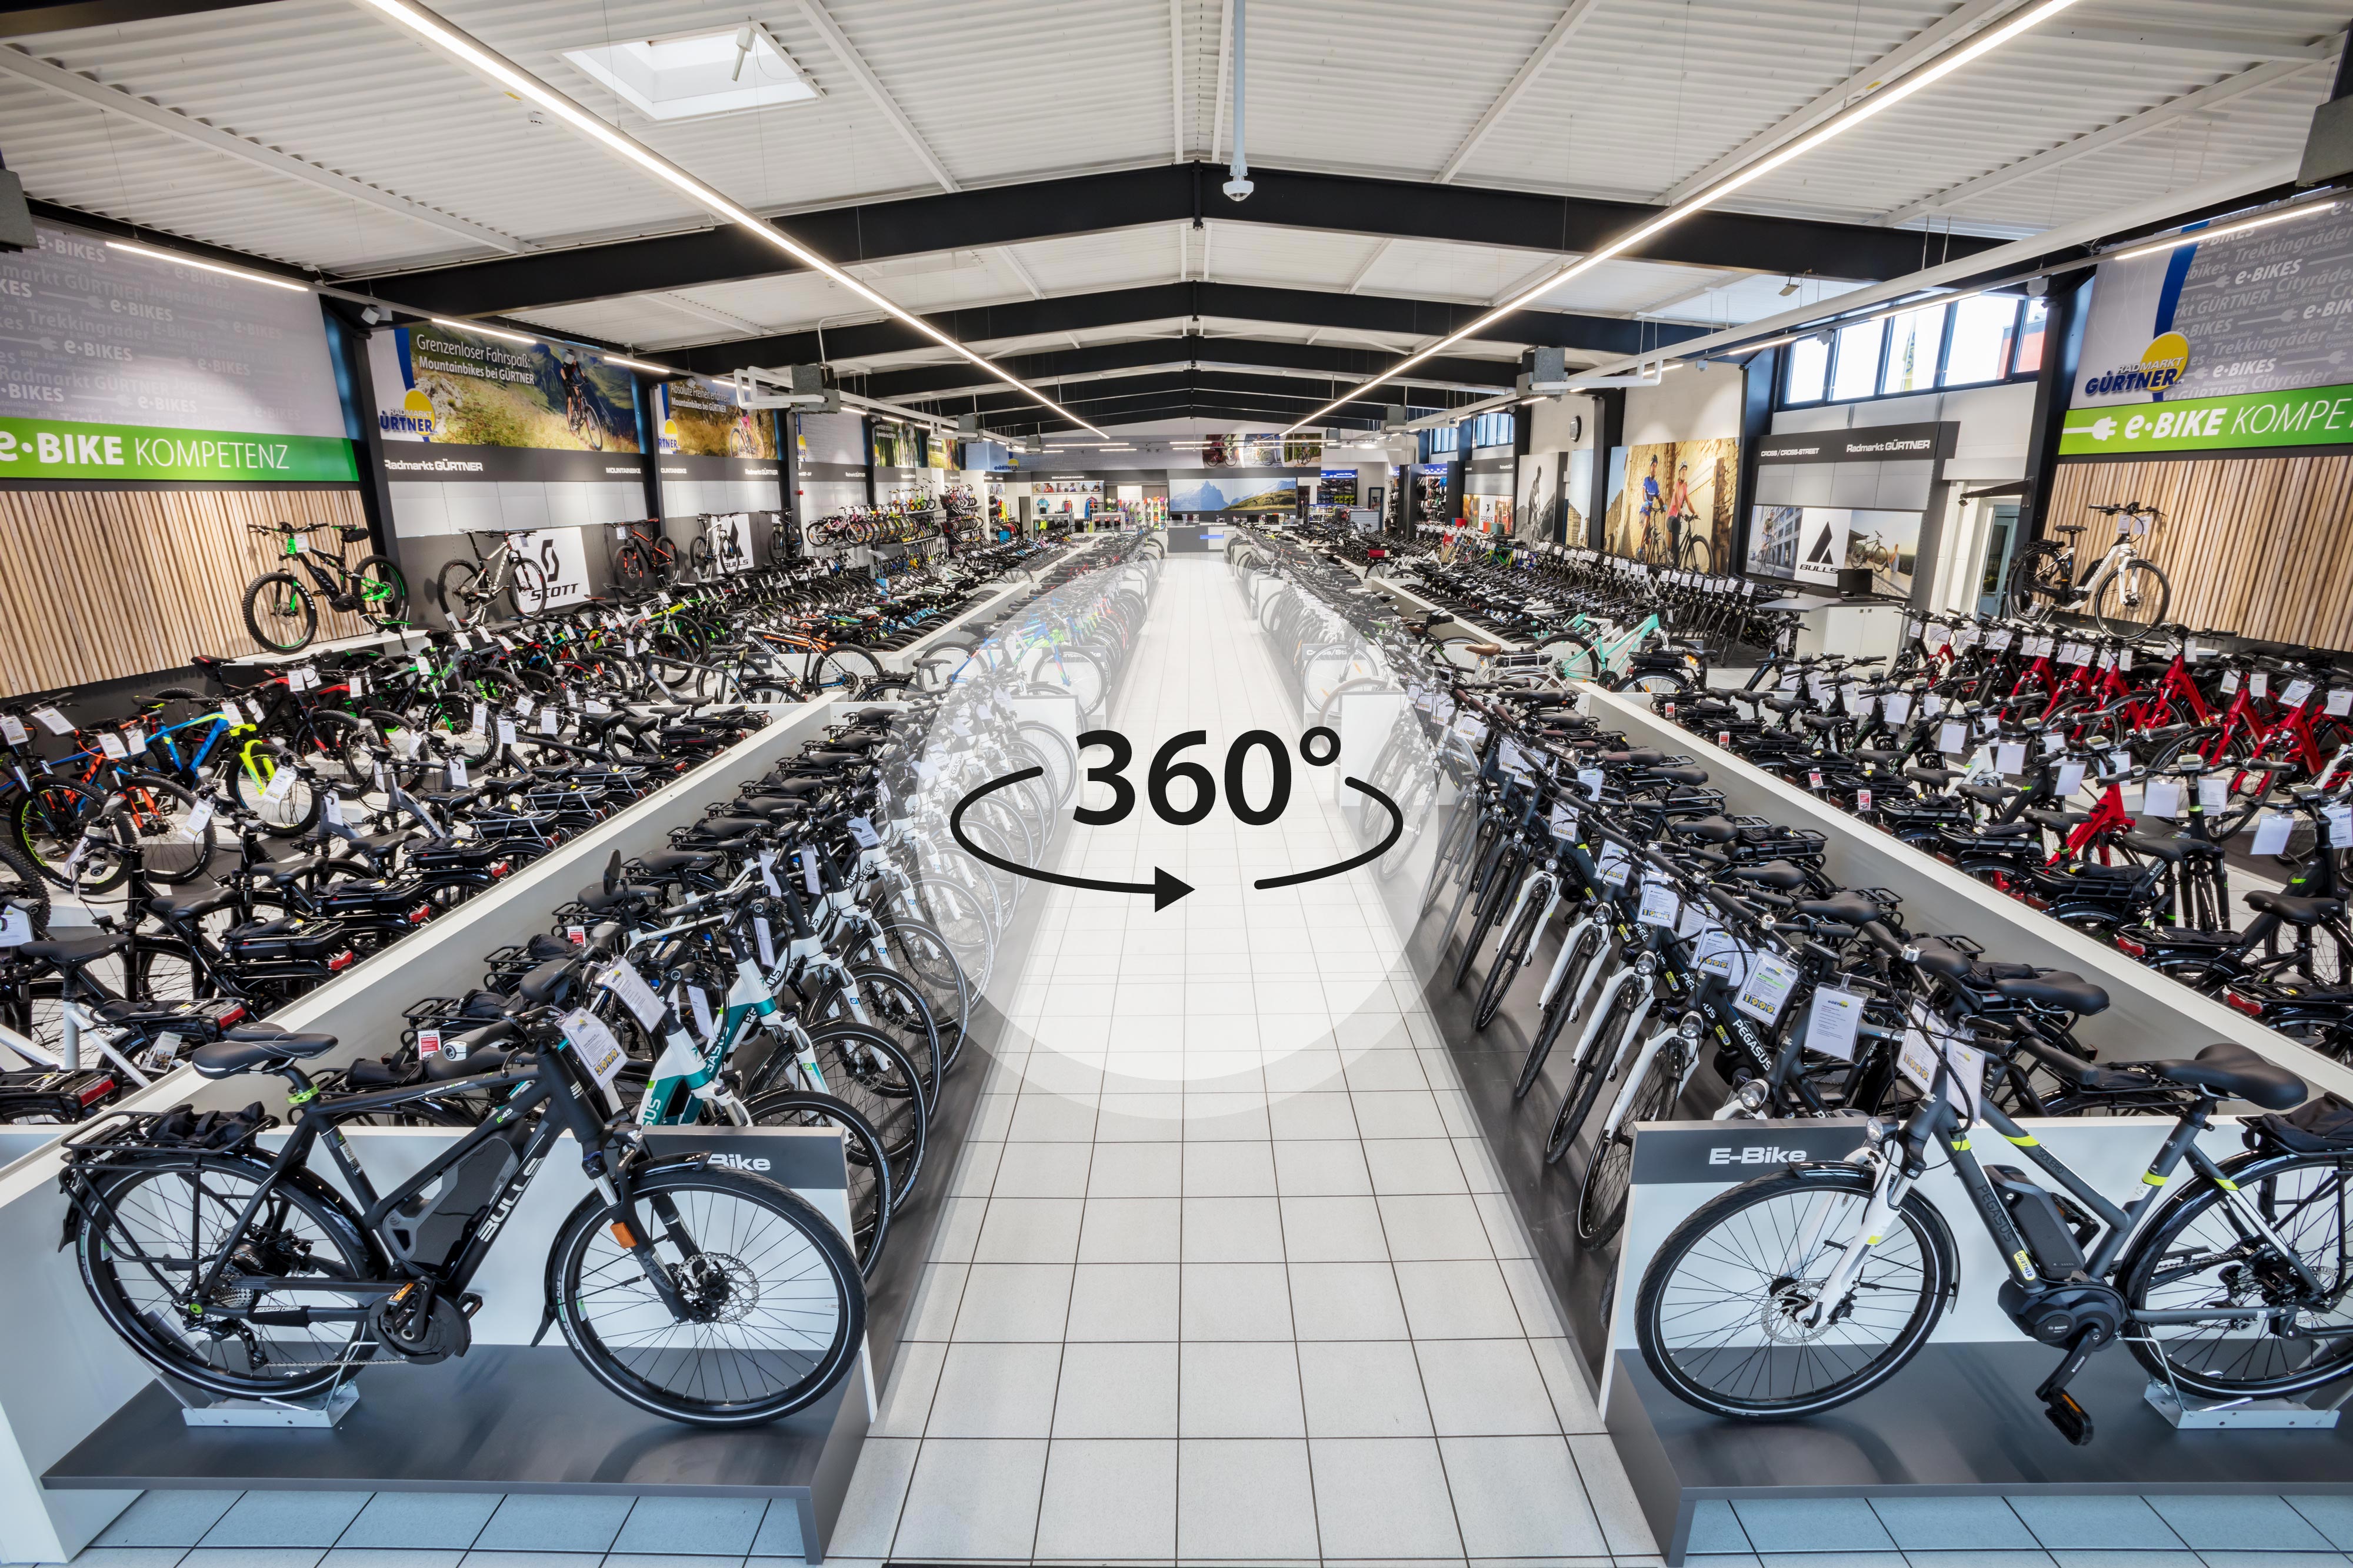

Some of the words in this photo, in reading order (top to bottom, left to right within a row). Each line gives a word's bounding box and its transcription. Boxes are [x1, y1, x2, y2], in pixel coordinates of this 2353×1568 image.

[2197, 288, 2271, 315] GÜRTNER
[26, 309, 149, 341] Trekkingräder
[416, 333, 484, 360] Grenzenloser
[486, 346, 531, 369] Fahrspaß:
[2212, 329, 2328, 356] Trekkingräder
[419, 355, 484, 377] Mountainbikes
[485, 368, 498, 378] bei
[499, 368, 534, 385] GÜRTNER
[2117, 355, 2185, 374] RADMARKT
[670, 383, 693, 397] Absolute
[2084, 368, 2178, 397] GÜRTNER
[2251, 368, 2334, 391] Cityräder
[389, 407, 432, 418] RADMARKT
[671, 396, 702, 410] Mountainbikes
[709, 402, 727, 413] GÜRTNER
[2231, 396, 2353, 436] KOMPE
[135, 438, 290, 469] KOMPETENZ
[1846, 443, 1884, 453] Radmarkt
[1884, 439, 1931, 452] GÜRTNER
[435, 458, 483, 472] GÜRTNER
[1799, 563, 1839, 575] BULLS
[1619, 925, 1629, 941] GÜRTNER
[1666, 972, 1678, 990] GÜRTNER
[1743, 993, 1775, 1016] 1999
[1716, 1025, 1729, 1045] GÜRTNER
[1732, 1019, 1772, 1072] PEGASUS
[1867, 1040, 1879, 1057] SOLERO
[595, 1049, 619, 1077] 3999
[1904, 1052, 1930, 1083] 1999
[425, 1086, 445, 1095] GREEN
[496, 1107, 513, 1124] E45
[1708, 1146, 1807, 1165] E-Bike
[2035, 1149, 2065, 1175] SOLERO
[477, 1156, 546, 1243] BULLS
[1976, 1182, 2012, 1243] PEGASUS
[2016, 1252, 2033, 1278] GÜRTNER
